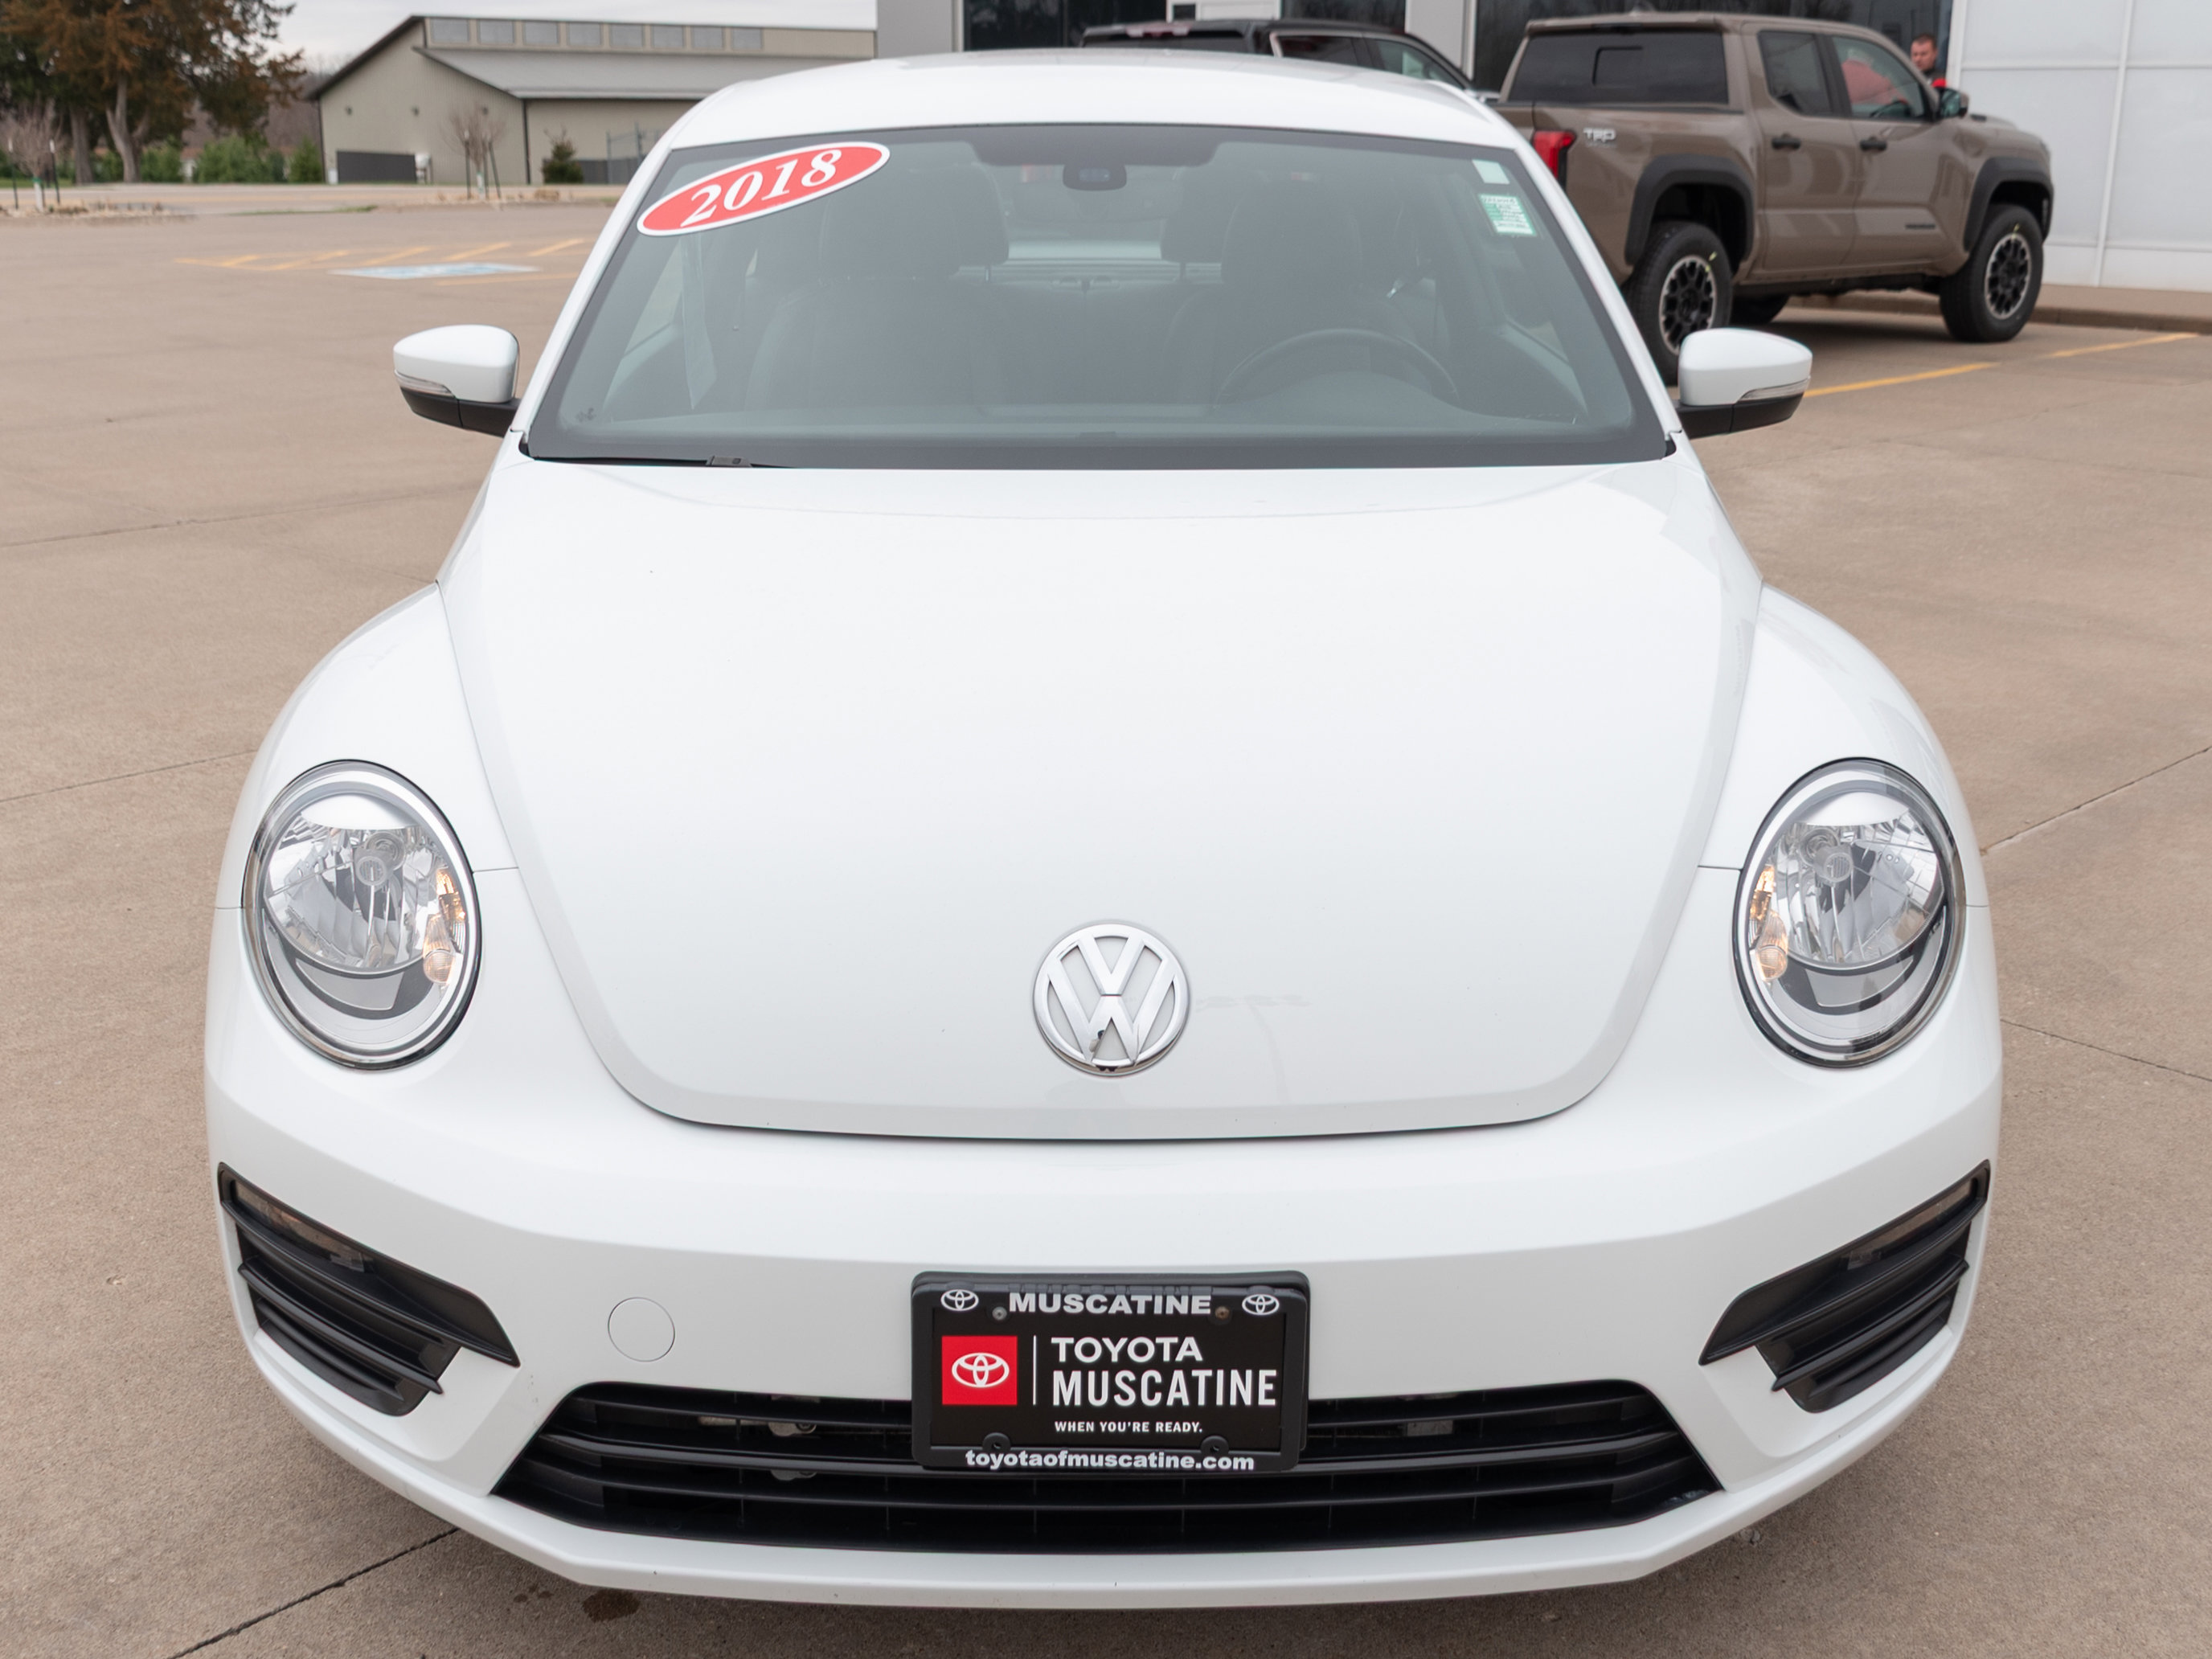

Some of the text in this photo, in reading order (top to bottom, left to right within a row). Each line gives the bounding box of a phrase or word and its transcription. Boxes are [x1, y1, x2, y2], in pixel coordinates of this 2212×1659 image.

[680, 149, 842, 228] 2018
[1009, 1292, 1212, 1316] MUSCATINE
[1051, 1336, 1204, 1362] TOYOTA
[1052, 1369, 1278, 1407] MUSCATINE
[1055, 1420, 1203, 1434] WHEN YOU'RE READY.
[965, 1448, 1255, 1471] toyotaofmuscatine.com
